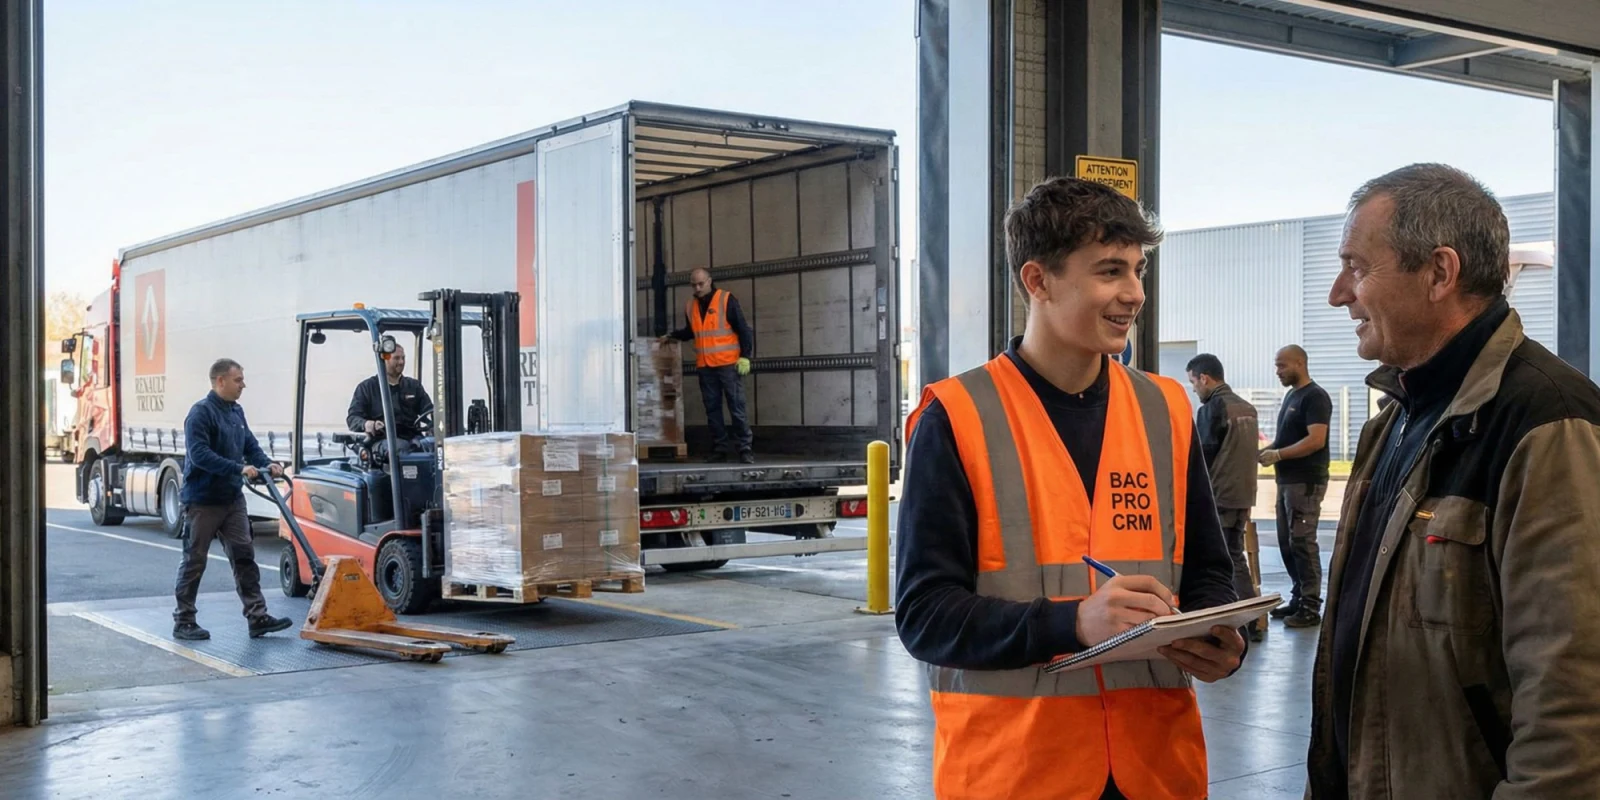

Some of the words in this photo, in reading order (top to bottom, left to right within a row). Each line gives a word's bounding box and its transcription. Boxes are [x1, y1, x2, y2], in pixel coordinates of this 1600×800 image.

[1086, 164, 1128, 177] ATTENTION
[135, 375, 166, 394] RENAULT
[136, 394, 165, 412] TRUCKS
[1110, 472, 1148, 489] BAC
[1111, 492, 1151, 510] PRO
[1112, 513, 1152, 531] CRM
